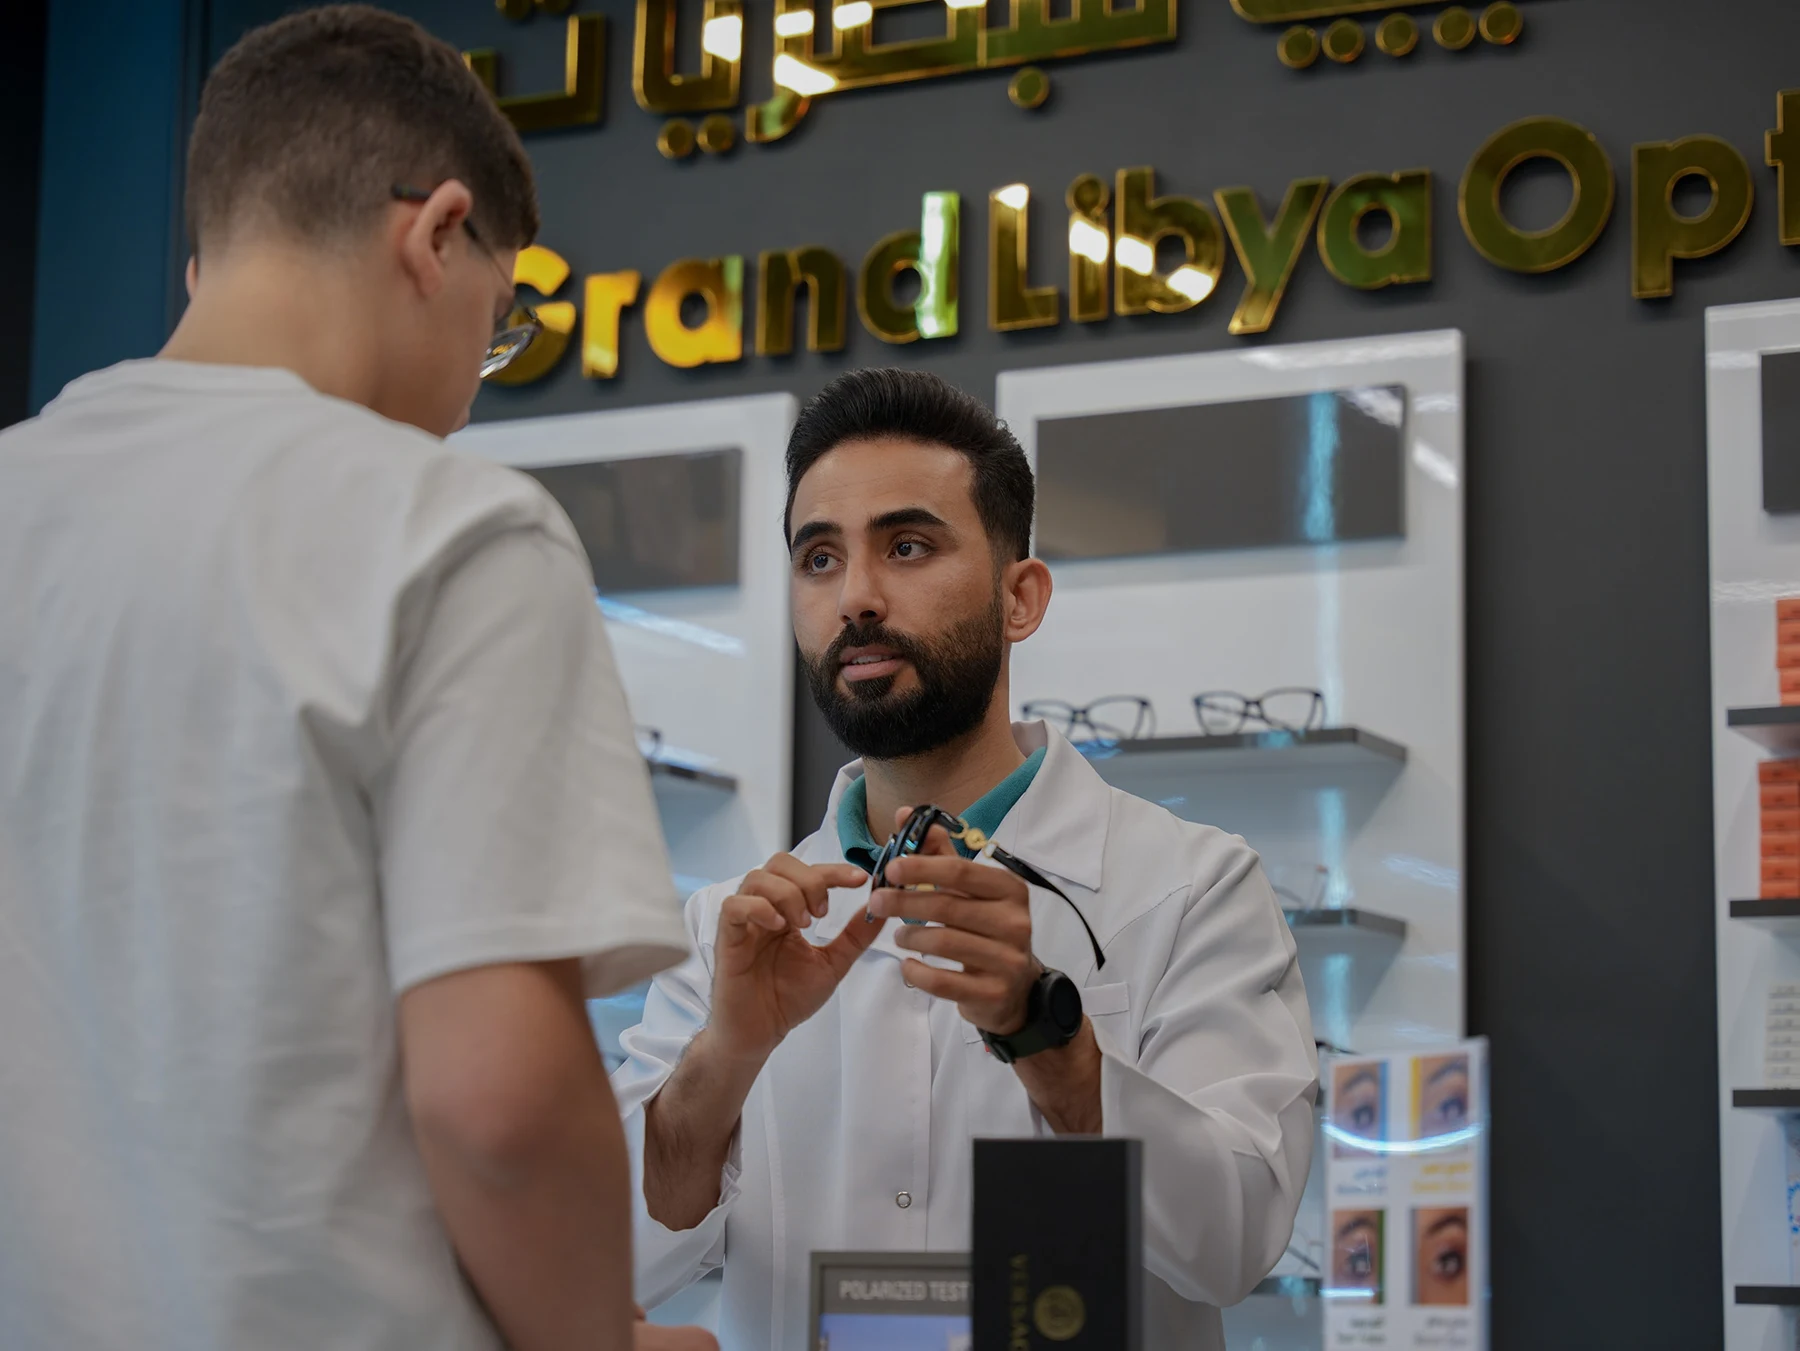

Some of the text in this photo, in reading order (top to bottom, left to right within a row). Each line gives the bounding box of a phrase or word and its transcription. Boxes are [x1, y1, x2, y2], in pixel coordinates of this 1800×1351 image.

[484, 191, 960, 386] Grand
[989, 166, 1432, 335] Libya
[839, 1280, 970, 1302] POLARIZED TEST
